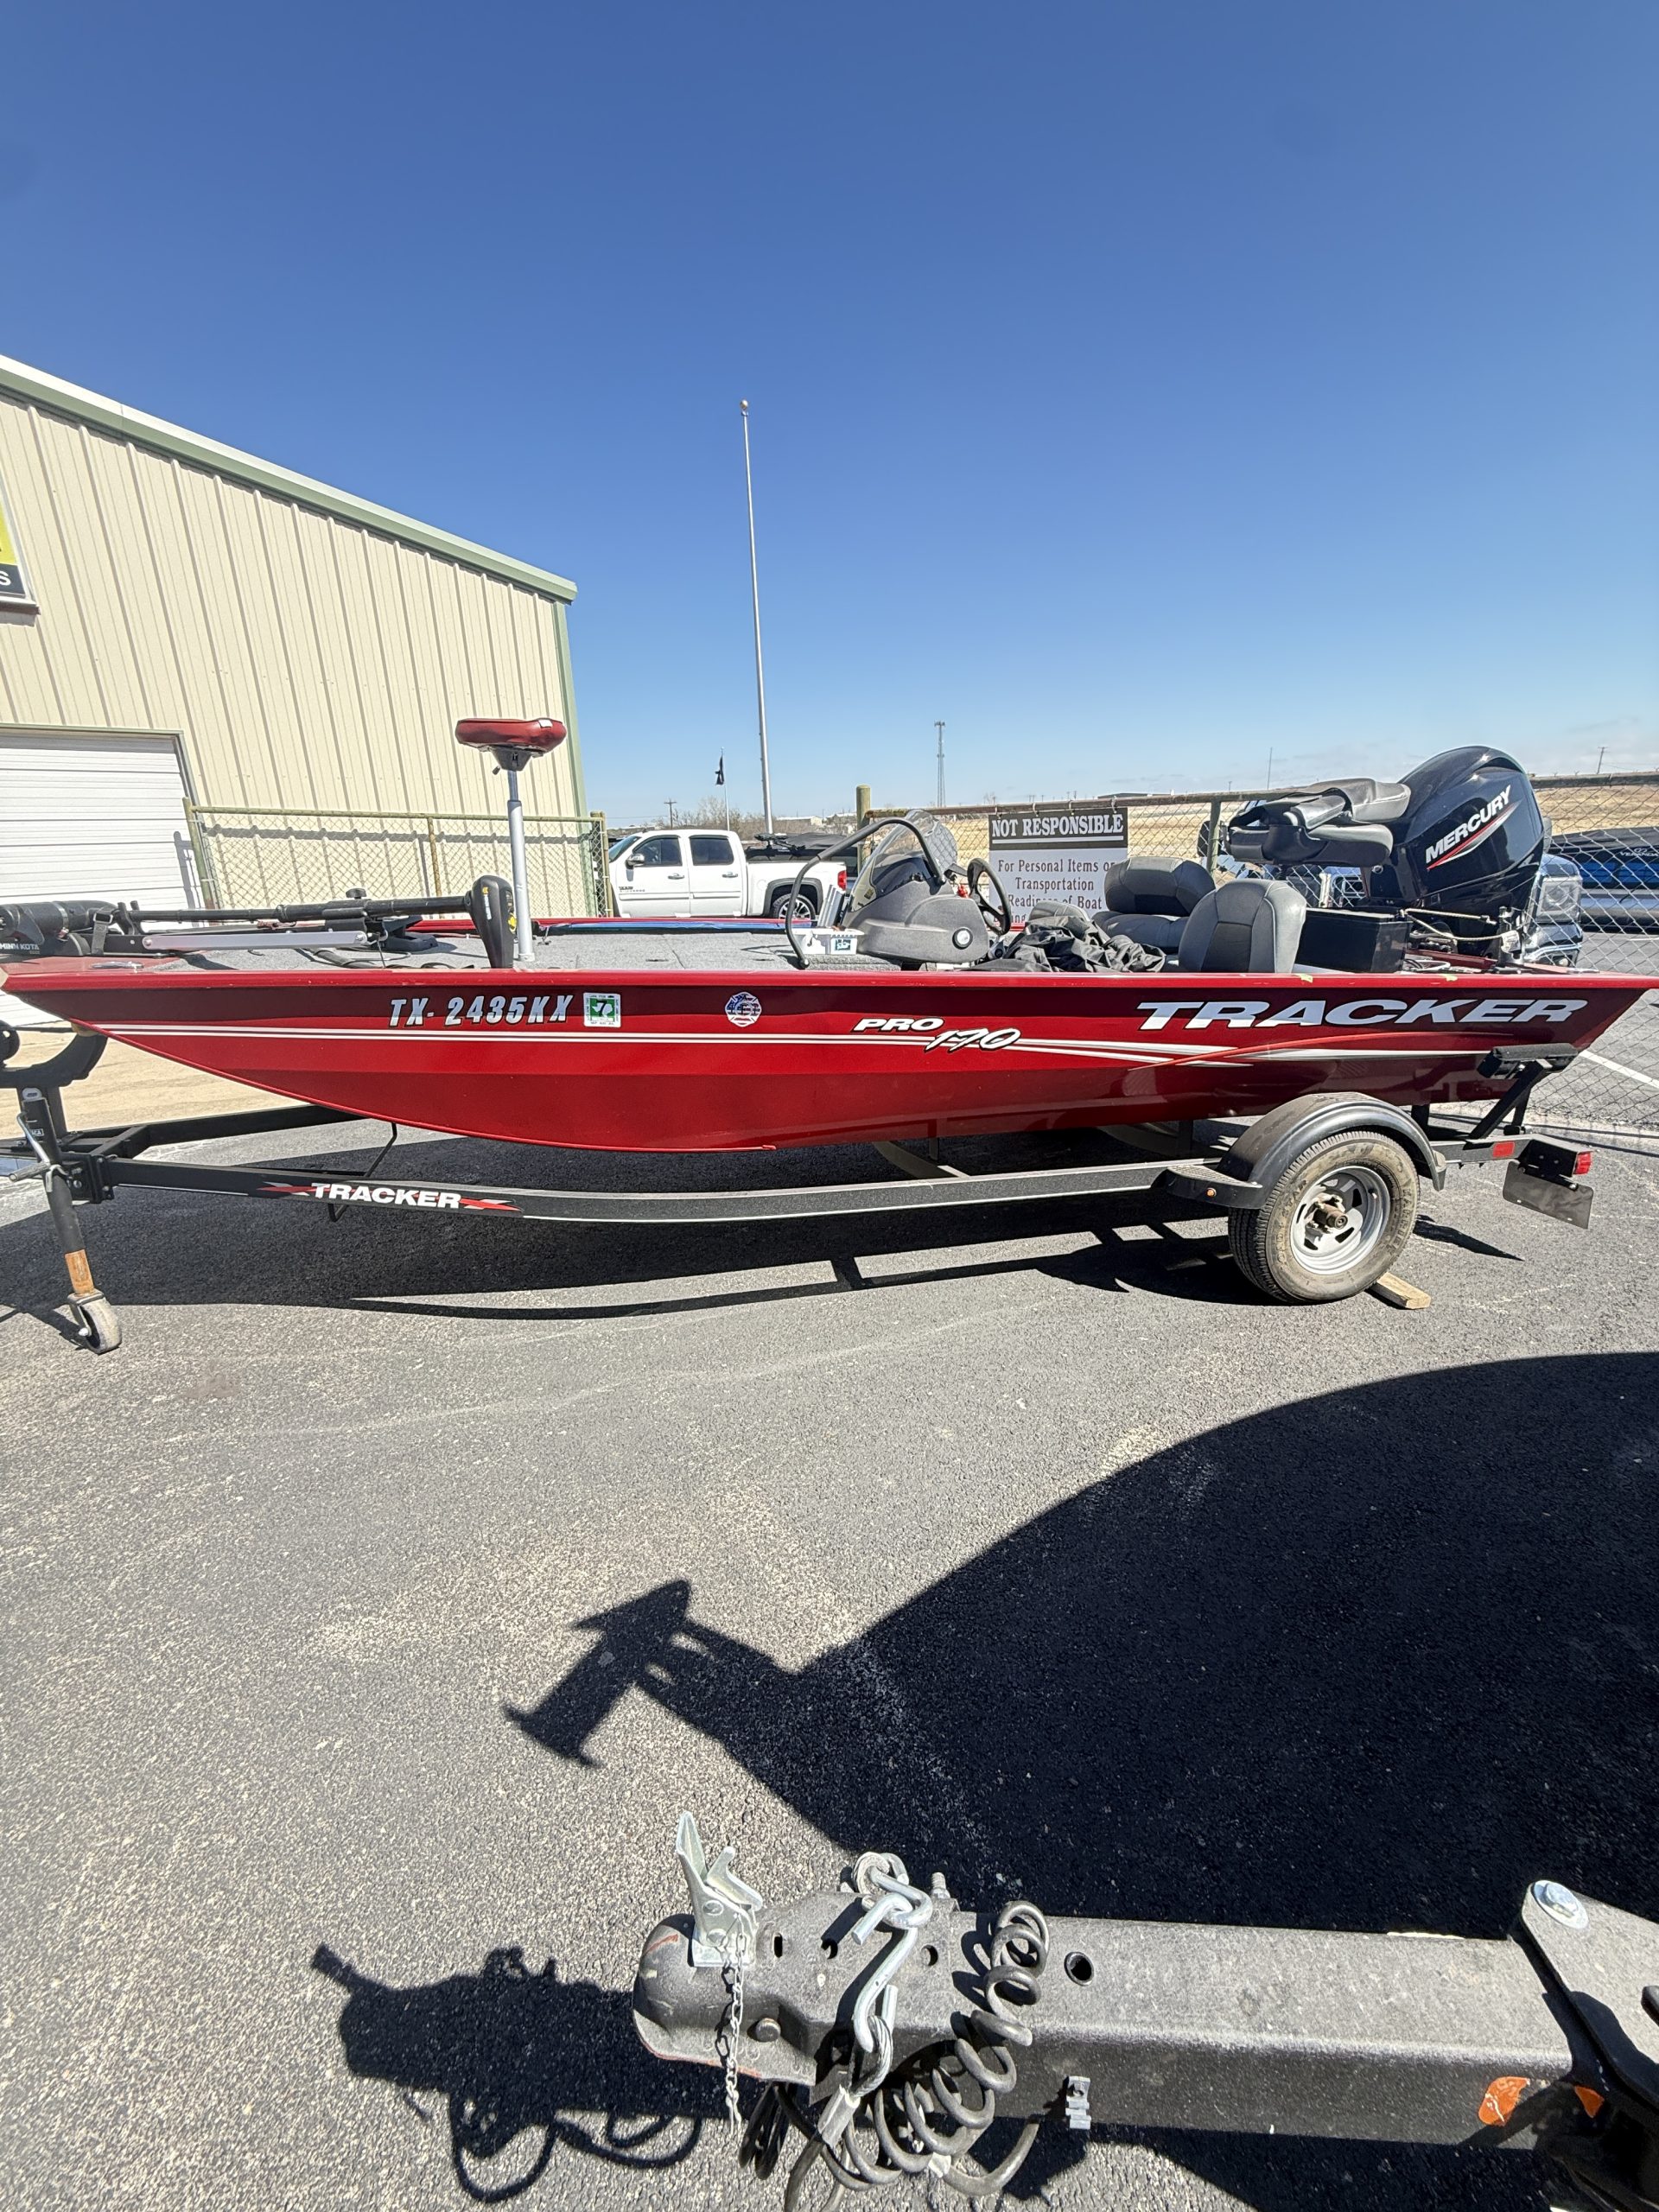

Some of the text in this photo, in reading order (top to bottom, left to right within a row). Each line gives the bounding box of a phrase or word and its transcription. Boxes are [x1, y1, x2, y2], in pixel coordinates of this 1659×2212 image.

[991, 814, 1123, 837] NOT RESPONSIBLE
[1426, 785, 1511, 864] MERCURY
[998, 859, 1014, 872] For
[1018, 858, 1063, 872] Personal
[1067, 858, 1098, 873] Items
[1015, 876, 1094, 893] Transportation
[1077, 895, 1102, 909] Boat
[444, 995, 574, 1026] 2435KX
[1137, 999, 1588, 1030] TRACKER
[851, 1017, 1021, 1052] PRO 170
[311, 1182, 462, 1209] TRACKER
